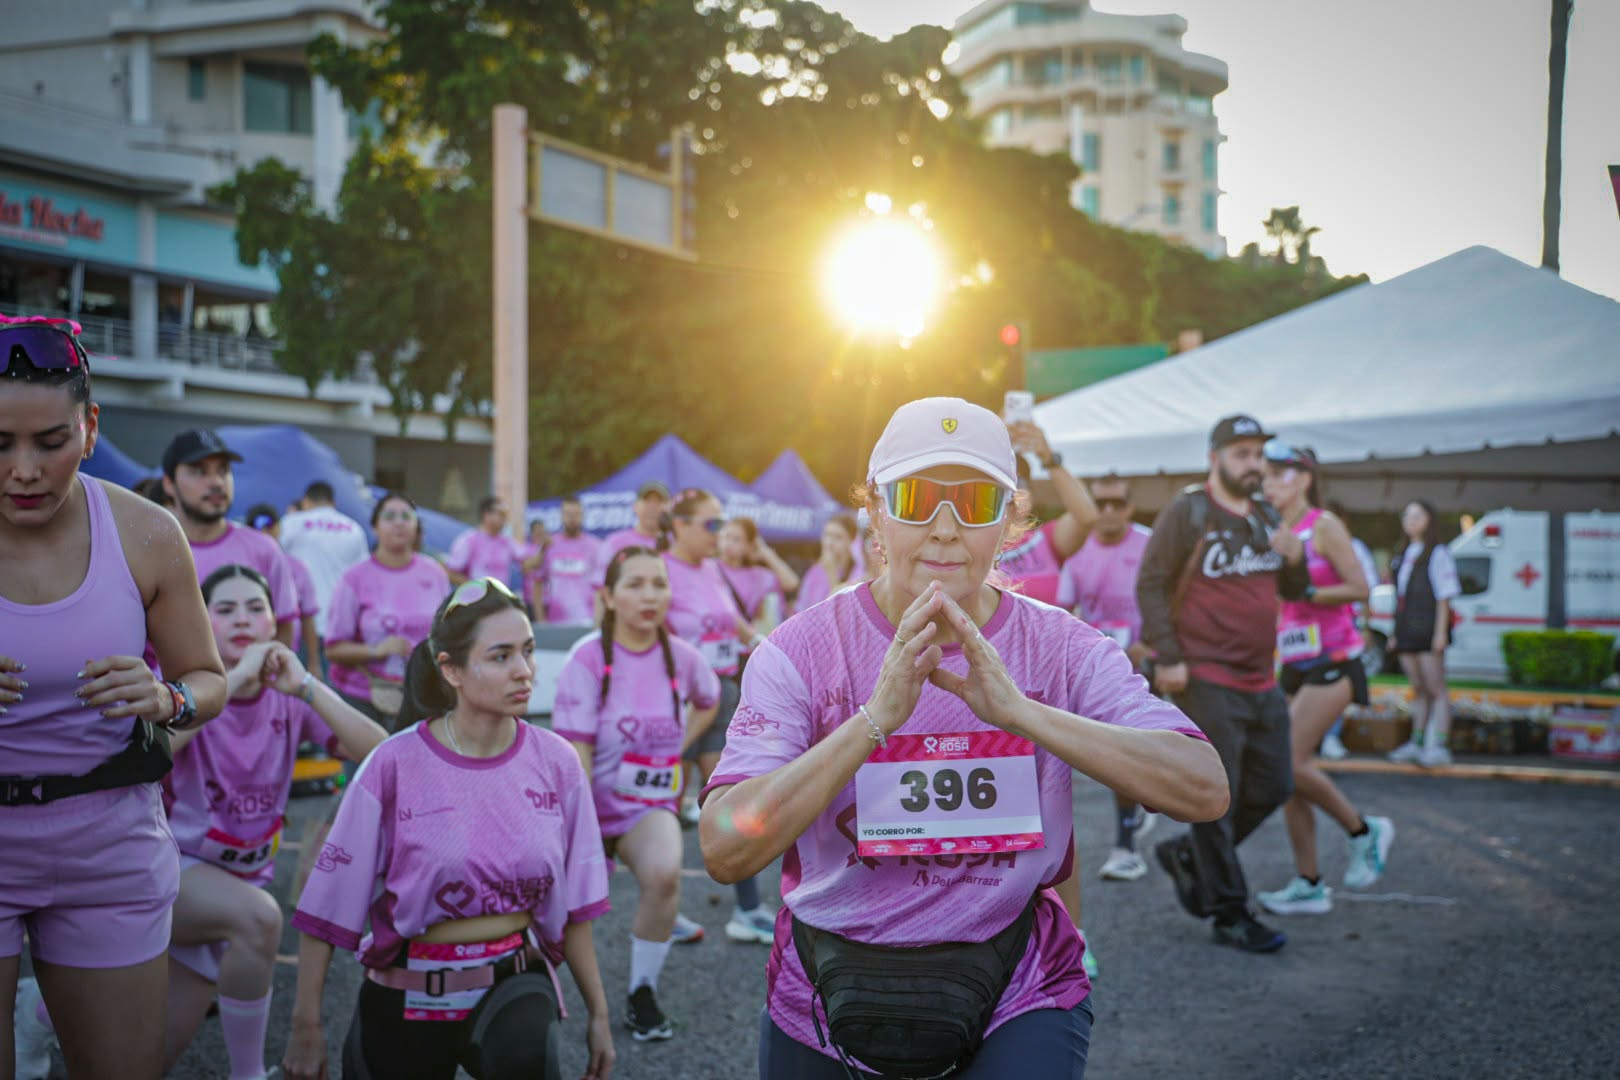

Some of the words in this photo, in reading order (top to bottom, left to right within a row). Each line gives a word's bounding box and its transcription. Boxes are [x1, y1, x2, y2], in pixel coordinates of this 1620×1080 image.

[939, 741, 969, 751] ROSA
[900, 767, 997, 812] 396
[875, 828, 905, 836] CORRO
[906, 827, 925, 835] POR:
